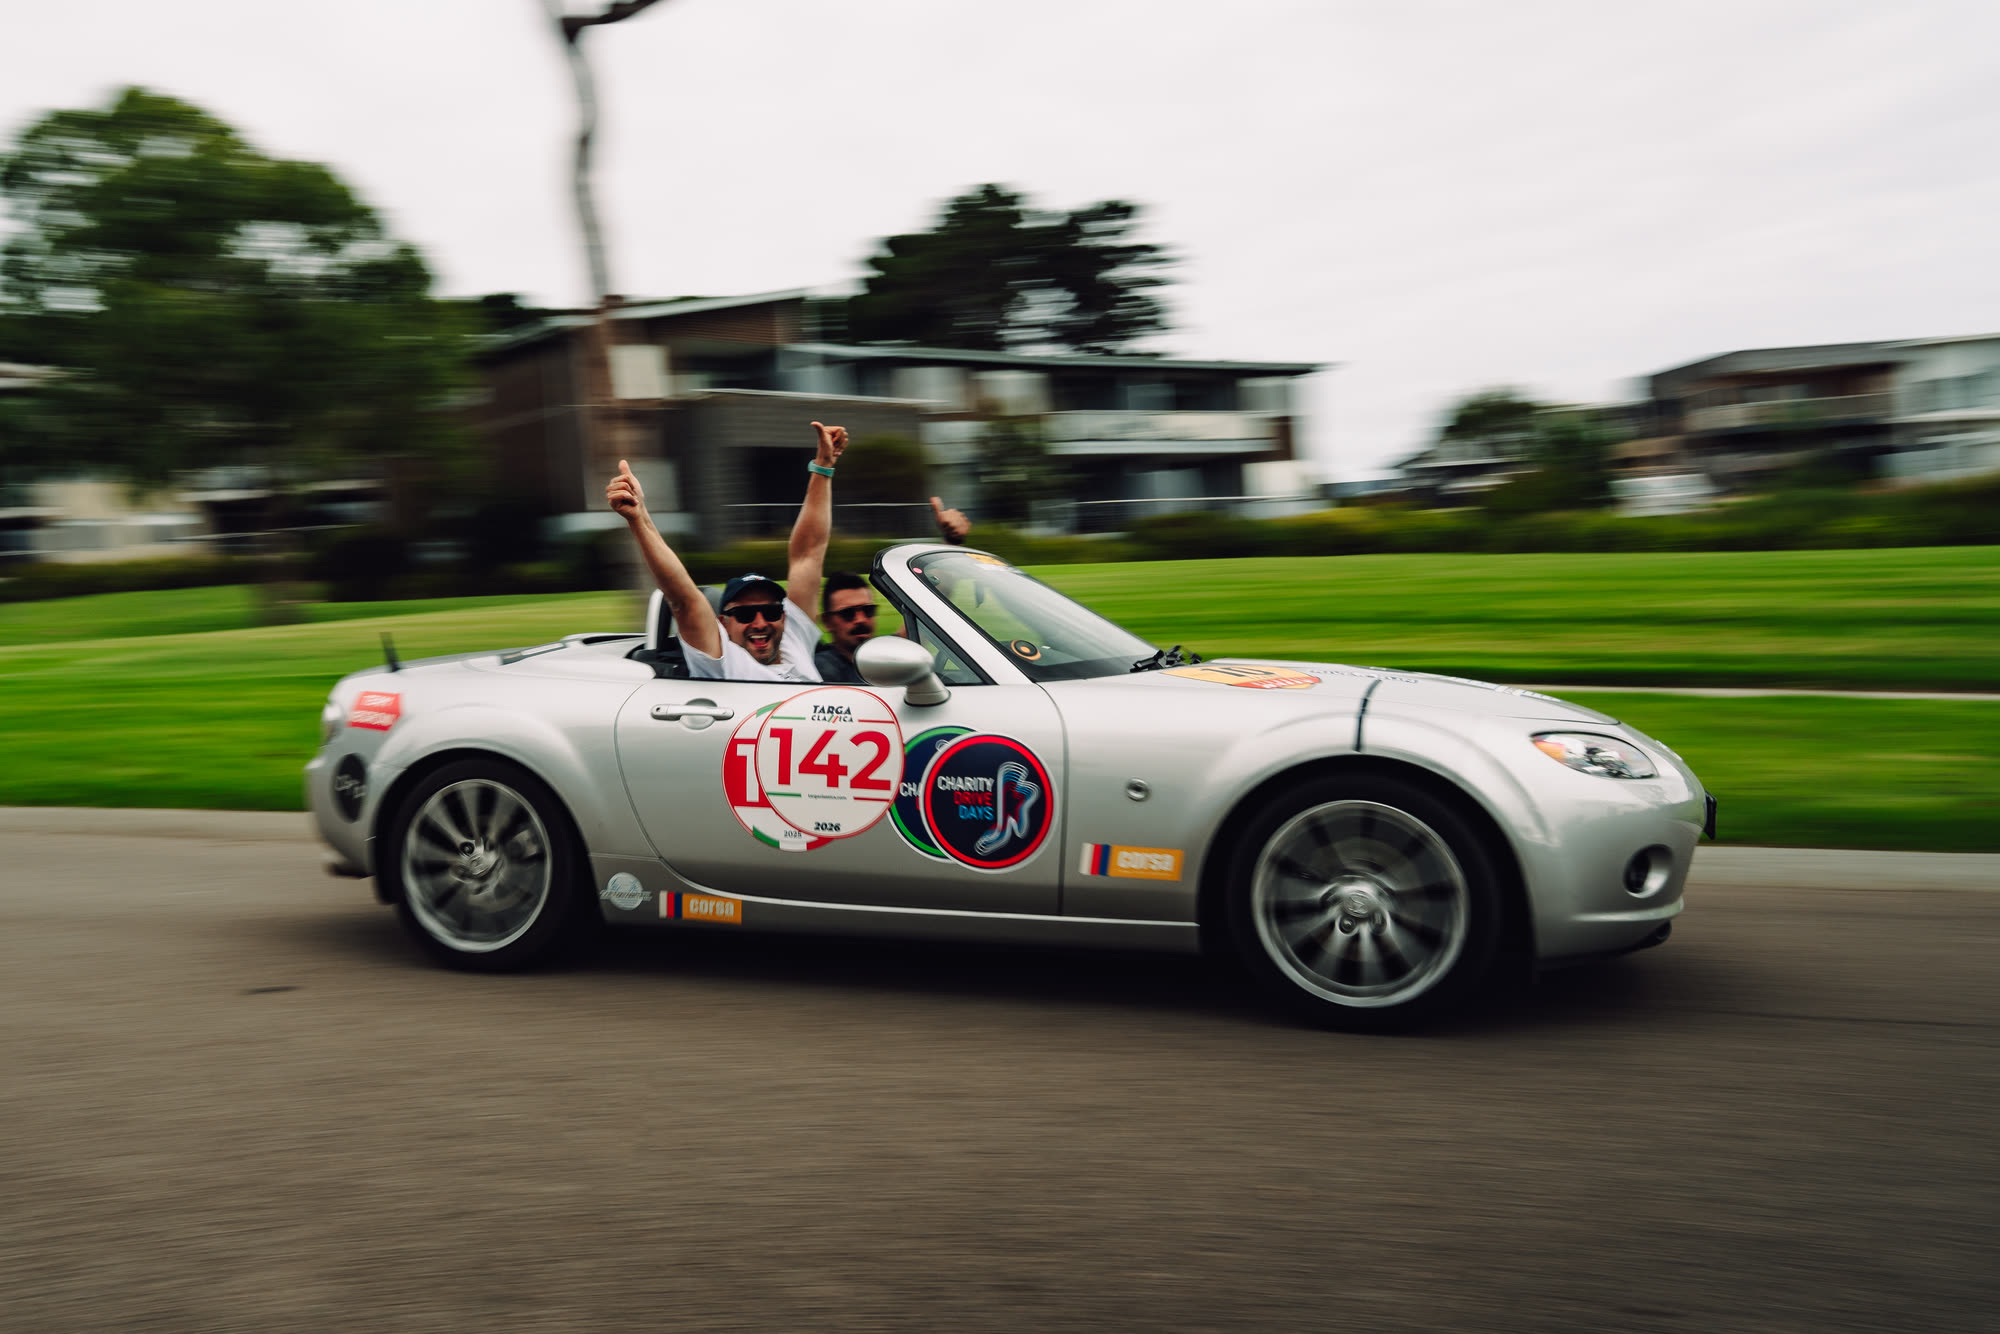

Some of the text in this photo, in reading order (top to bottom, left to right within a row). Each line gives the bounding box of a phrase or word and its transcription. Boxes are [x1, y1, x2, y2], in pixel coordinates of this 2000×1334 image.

[812, 705, 852, 715] TARGA
[769, 727, 892, 791] 142
[937, 775, 995, 792] CHARITY
[953, 790, 993, 807] DRIVE
[958, 804, 995, 820] DAYS
[814, 821, 841, 833] 2026
[1117, 851, 1175, 872] corsa
[689, 898, 735, 917] corsa
